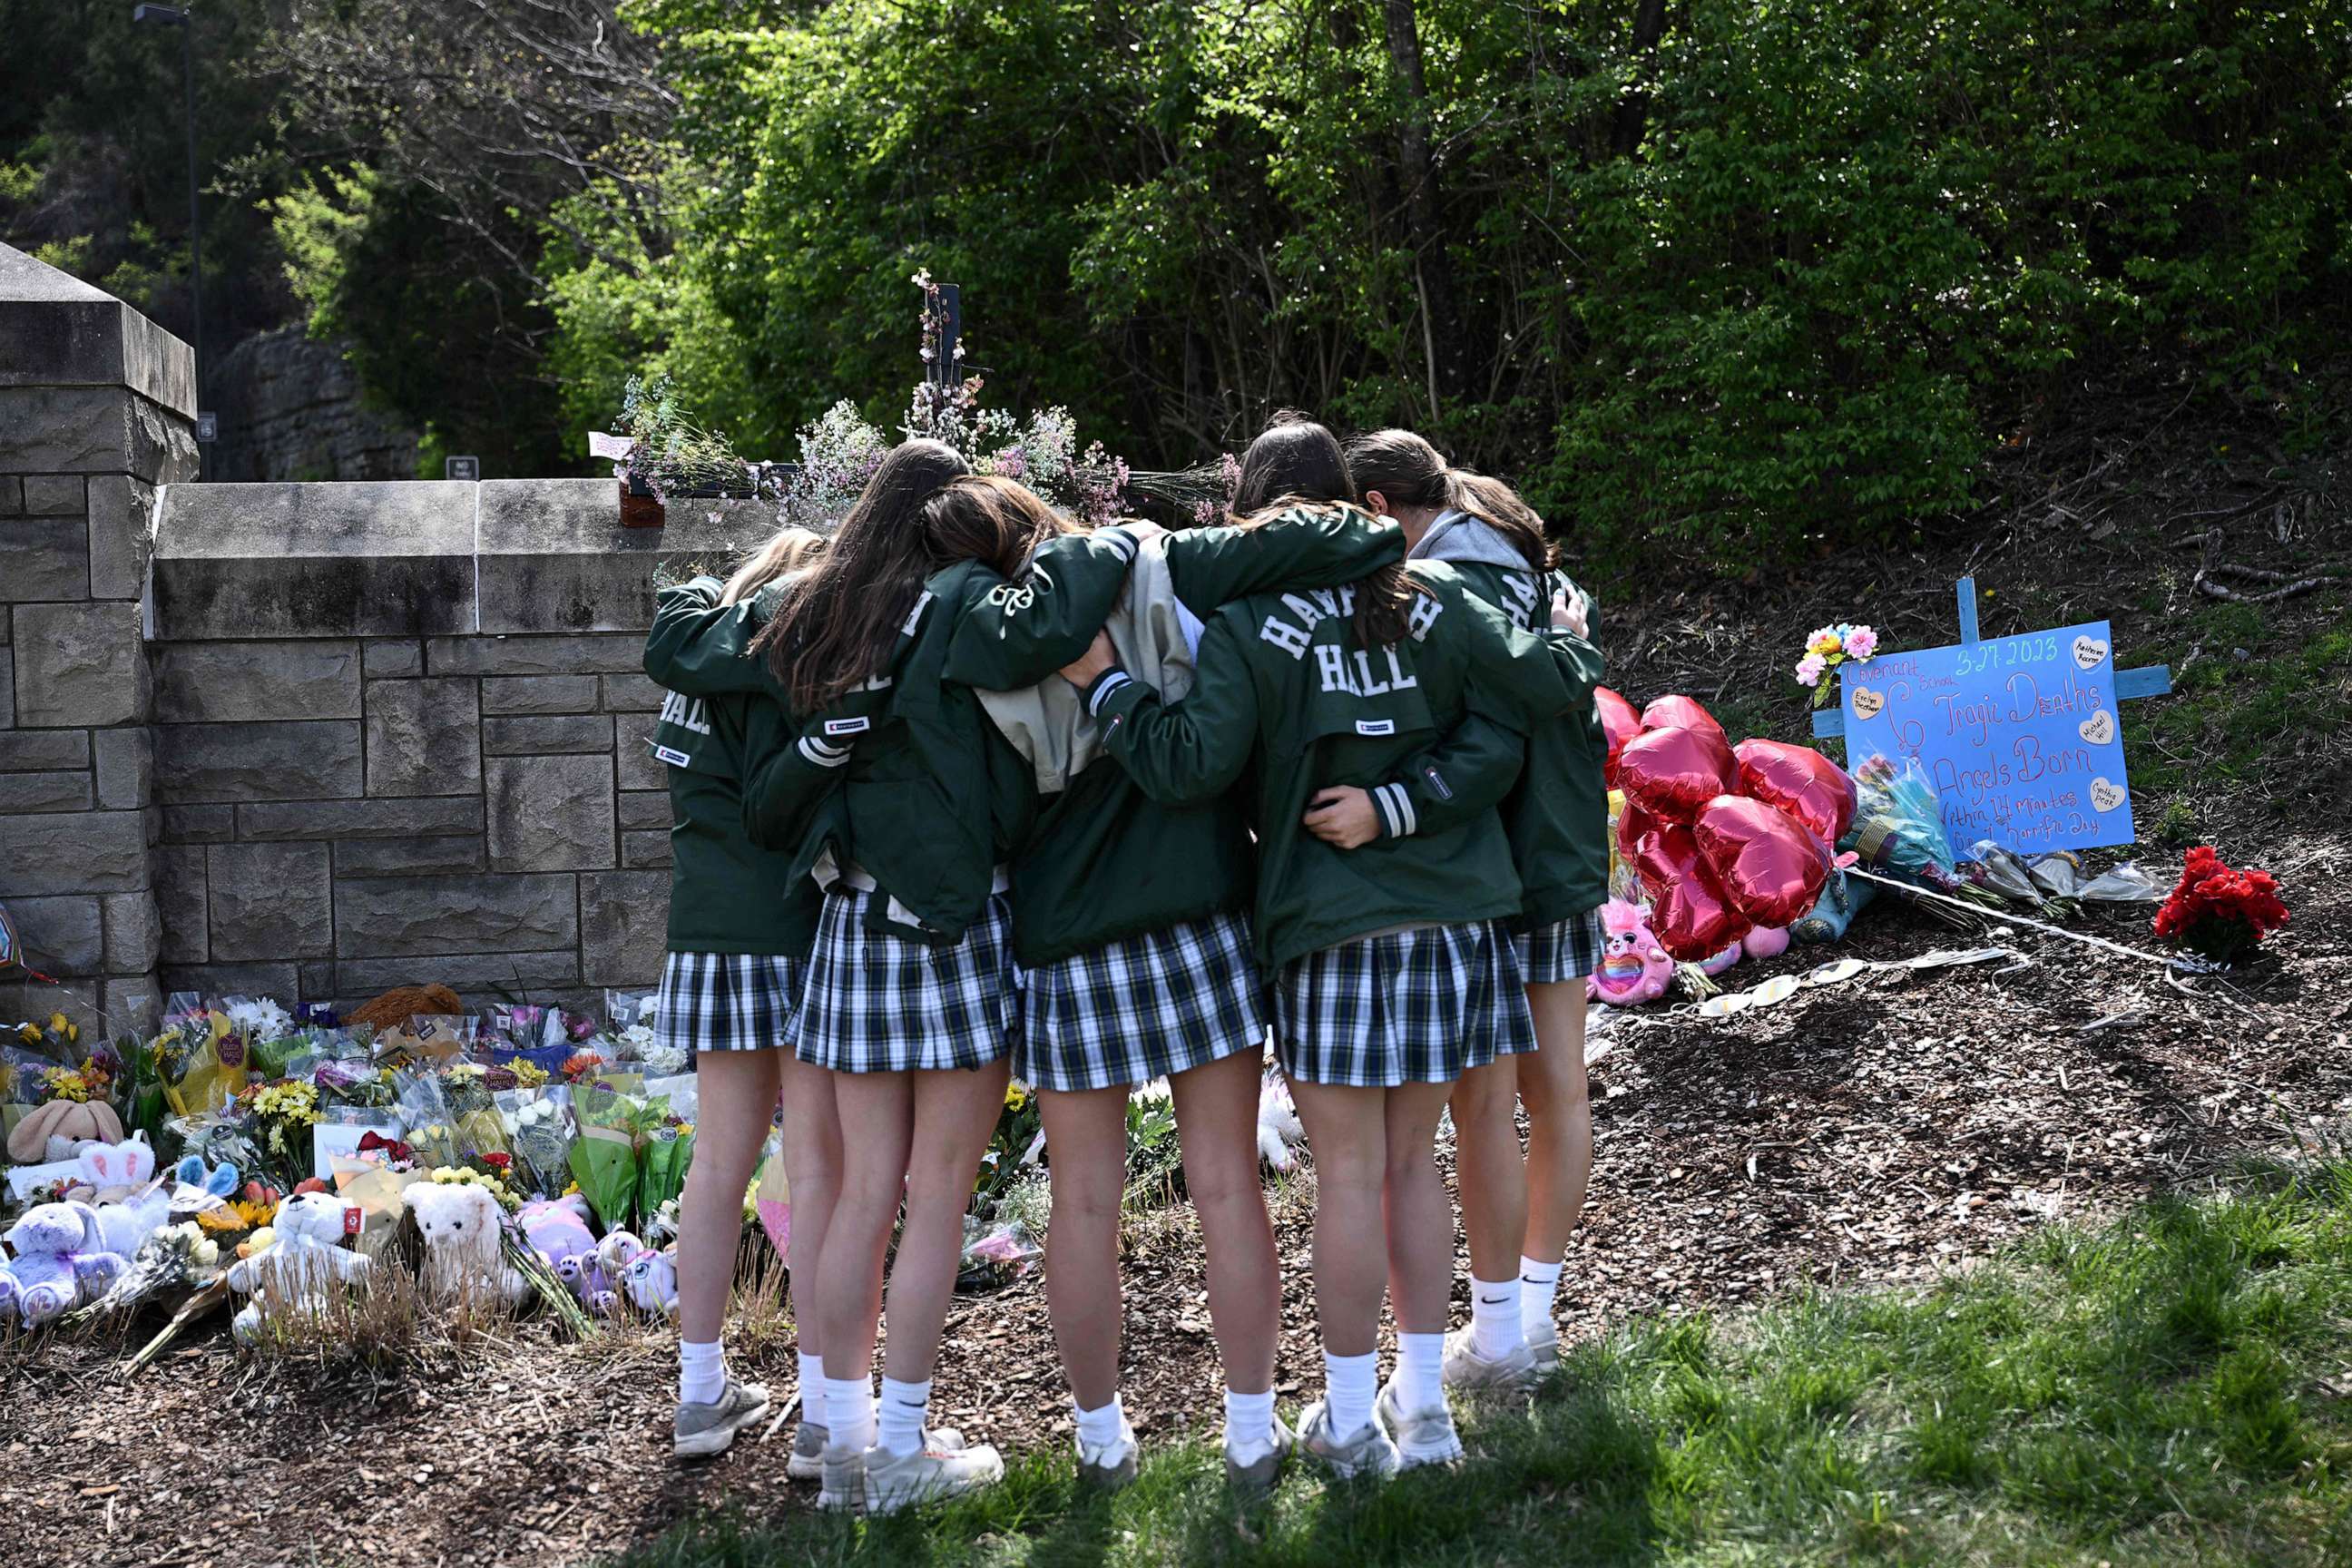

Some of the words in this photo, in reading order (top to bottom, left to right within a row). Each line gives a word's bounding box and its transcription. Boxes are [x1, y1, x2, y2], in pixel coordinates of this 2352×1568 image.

[1847, 658, 1919, 685] Covenant
[1933, 691, 2004, 747] Tragic
[1934, 751, 2012, 807] Angels
[2013, 735, 2094, 782] Born
